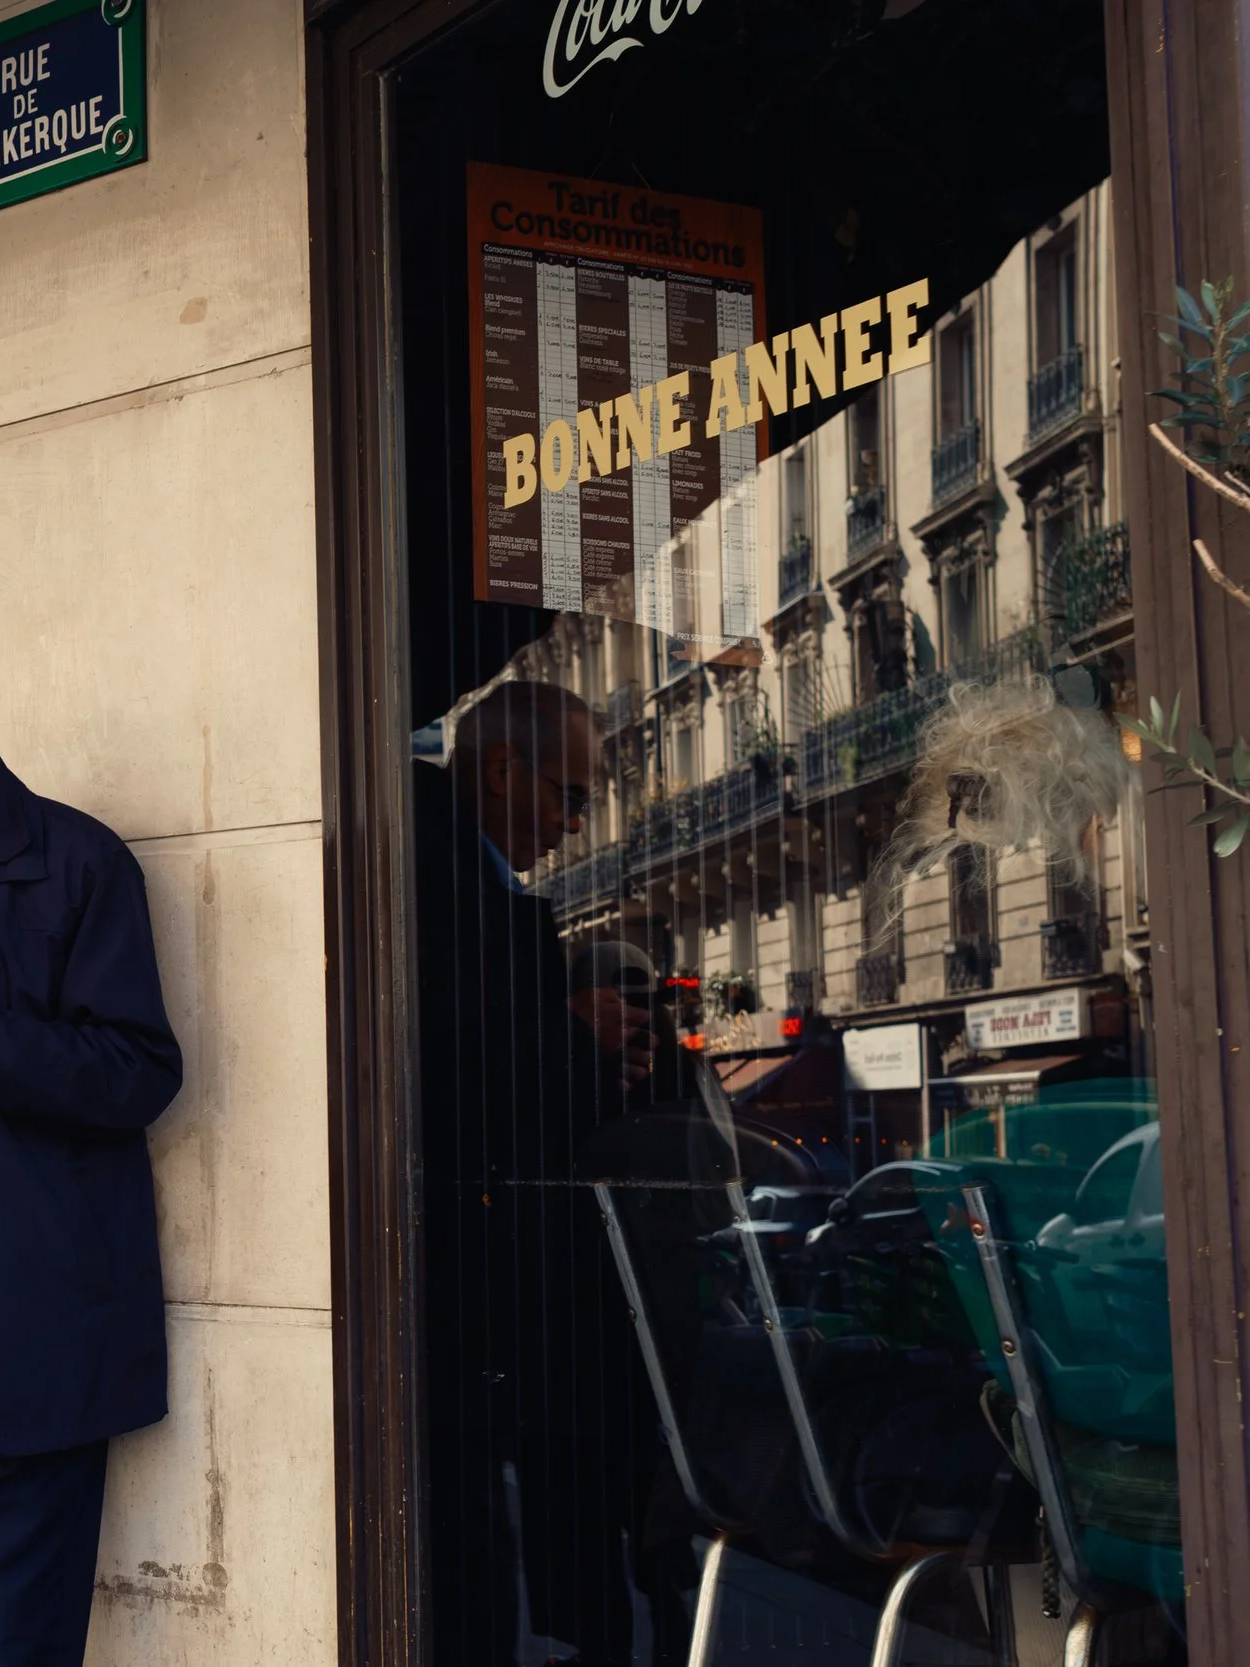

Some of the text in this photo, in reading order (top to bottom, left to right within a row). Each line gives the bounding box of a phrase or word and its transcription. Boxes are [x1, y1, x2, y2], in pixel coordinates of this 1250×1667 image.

[2, 42, 50, 94] RUE
[14, 88, 38, 119] DE
[548, 181, 683, 230] Tarif des
[490, 201, 748, 268] Consommations
[483, 243, 532, 258] Consommations
[577, 257, 624, 271] Consommations
[667, 271, 712, 285] Consommations
[503, 277, 932, 509] BONNE ANNEE
[490, 579, 538, 590] BIERES PRESSION
